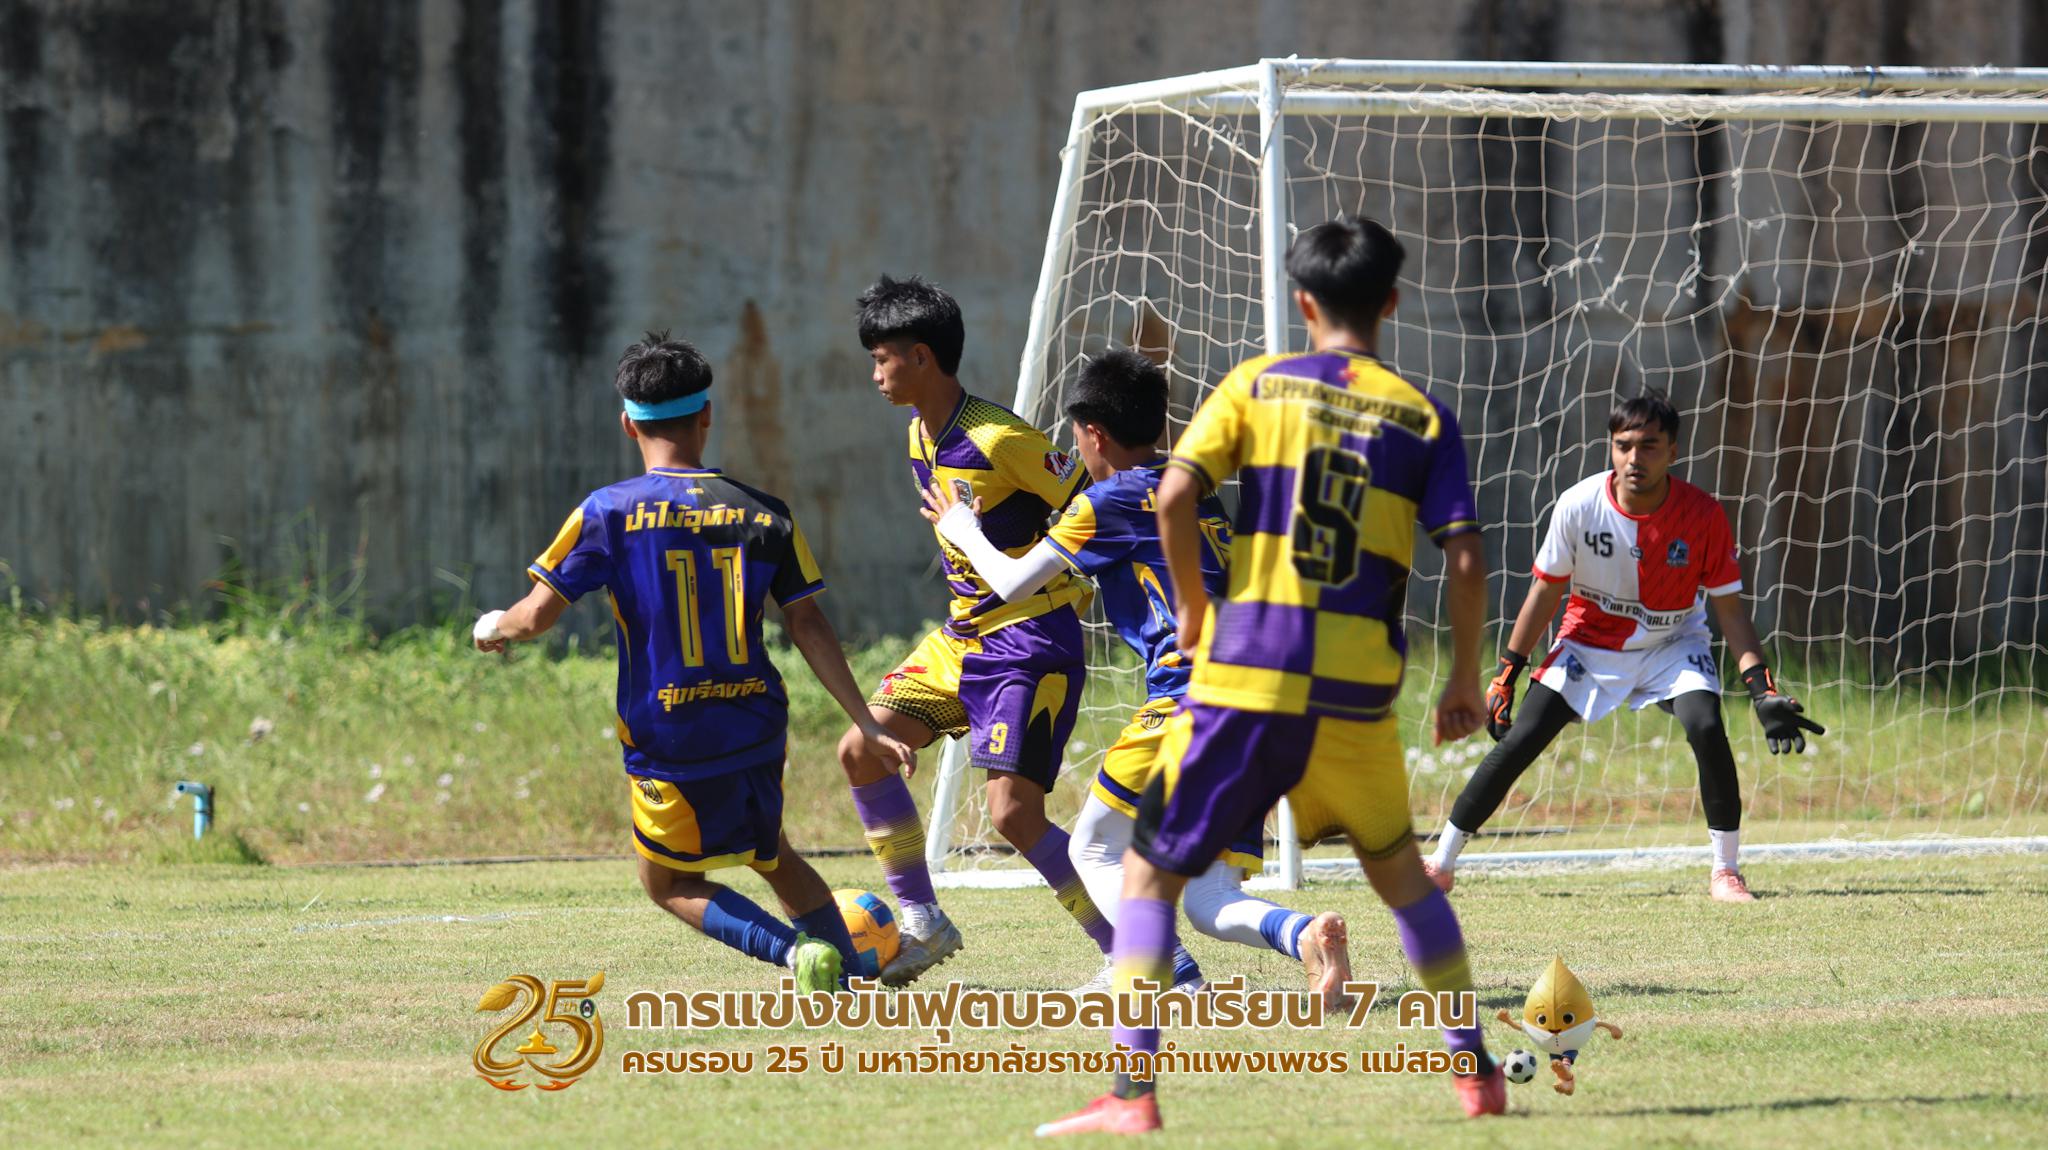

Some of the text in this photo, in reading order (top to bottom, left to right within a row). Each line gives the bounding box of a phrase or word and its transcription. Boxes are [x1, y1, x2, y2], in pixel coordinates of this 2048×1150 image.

[754, 512, 773, 527] 4
[1292, 444, 1371, 588] 5
[1584, 531, 1614, 557] 45
[665, 547, 749, 667] 11
[1688, 653, 1715, 677] 45
[989, 722, 1008, 754] 9
